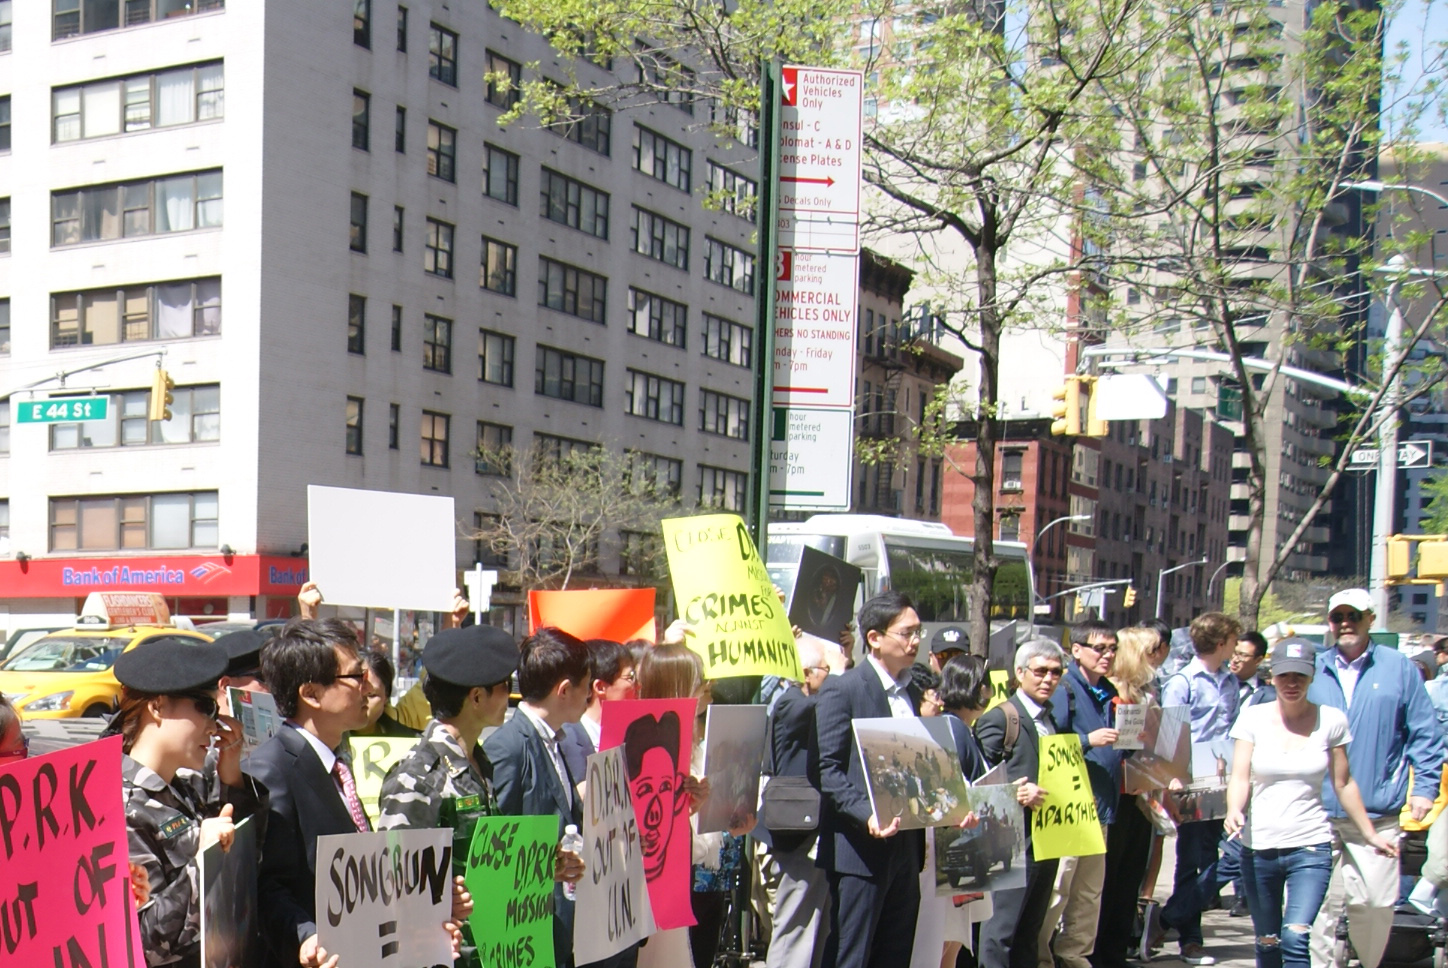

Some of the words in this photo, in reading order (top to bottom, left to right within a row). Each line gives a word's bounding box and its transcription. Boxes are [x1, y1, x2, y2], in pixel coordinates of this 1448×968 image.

[803, 73, 855, 88] Authorized
[803, 86, 842, 98] Vehicles
[802, 97, 823, 111] Only
[780, 120, 804, 130] nsul
[814, 120, 820, 132] C
[780, 136, 814, 148] plomat
[826, 138, 832, 149] A
[845, 140, 852, 150] D
[811, 154, 842, 166] Plates
[784, 195, 810, 206] Decals
[814, 197, 832, 208] Only
[795, 264, 827, 273] metered
[795, 274, 822, 284] parking
[776, 290, 841, 306] OMMERCIAL
[774, 306, 818, 321] EHICLES
[822, 308, 851, 322] ONLY
[774, 328, 794, 338] HERS
[796, 329, 808, 338] NO
[811, 330, 850, 340] STANDING
[775, 347, 797, 359] nday
[806, 348, 833, 360] Friday
[789, 360, 808, 372] 7pm
[32, 404, 43, 420] E
[46, 402, 68, 418] 44
[72, 402, 92, 418] St
[789, 412, 806, 420] hour
[789, 423, 821, 432] metered
[788, 432, 817, 442] parking
[770, 451, 800, 462] turday
[786, 464, 805, 476] 7pm
[674, 526, 733, 552] CLOSE
[62, 566, 101, 586] Bank
[102, 566, 119, 586] of
[120, 566, 184, 585] America
[269, 566, 294, 584] Bank
[686, 592, 774, 626] CRIMES
[716, 619, 766, 634] AGAINST
[708, 638, 798, 678] HUMANITY
[1034, 802, 1098, 832] APARTHIE
[471, 822, 520, 870] CLOSE
[593, 827, 616, 885] OUT
[74, 841, 118, 916] OF
[328, 844, 452, 928] SONGBUN
[506, 892, 553, 932] MISSION
